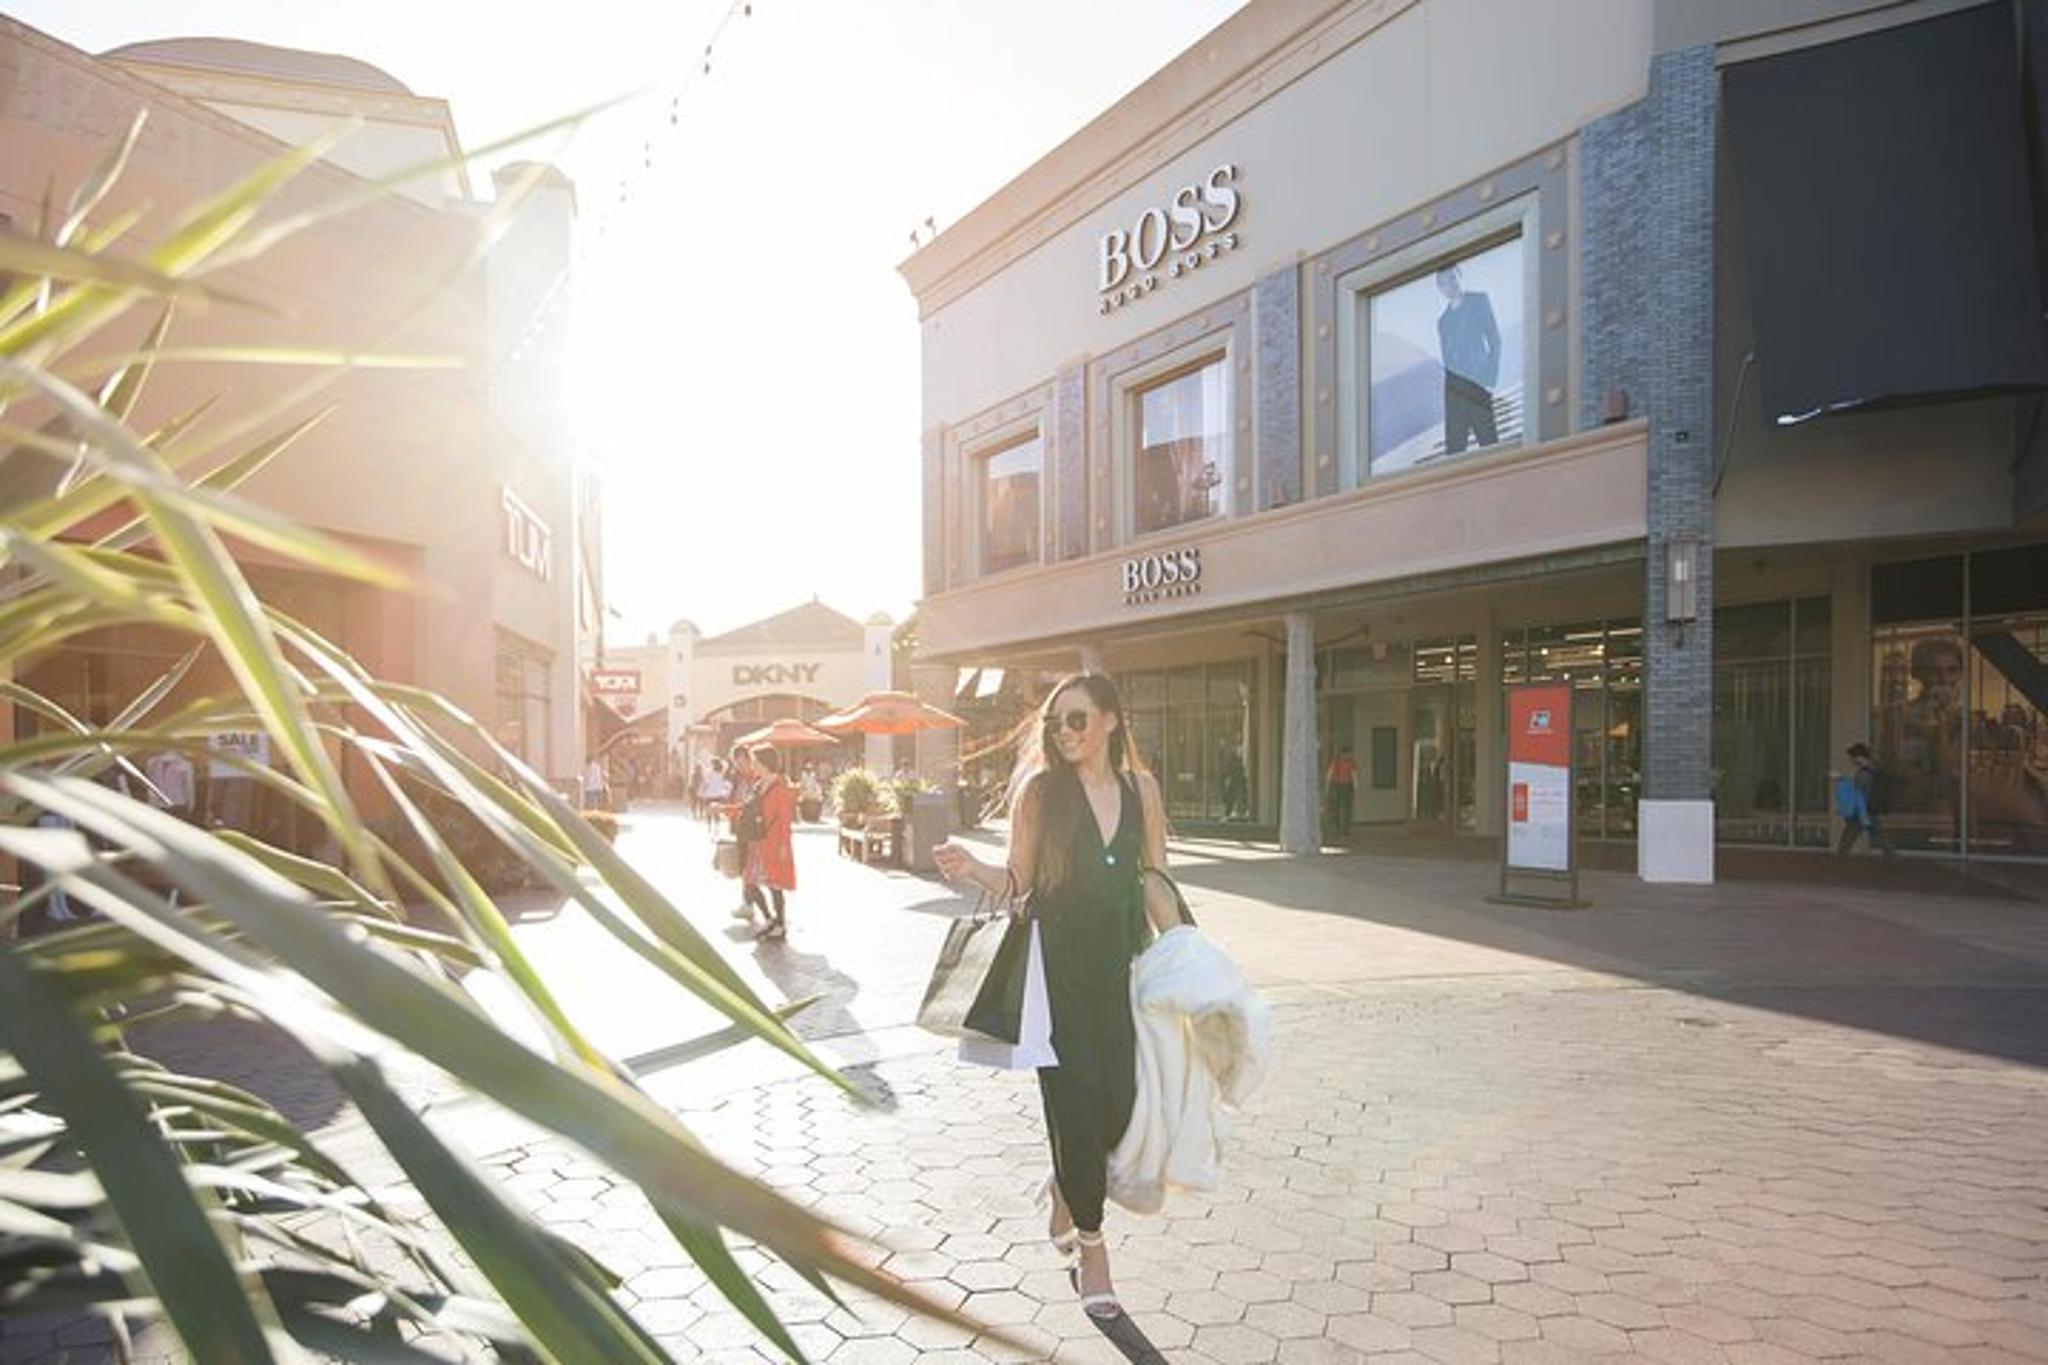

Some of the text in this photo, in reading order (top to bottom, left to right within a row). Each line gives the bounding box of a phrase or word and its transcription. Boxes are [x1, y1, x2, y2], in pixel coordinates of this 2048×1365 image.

[1100, 164, 1240, 293] BOSS
[1122, 548, 1200, 593] BOSS
[733, 663, 822, 685] DKNY
